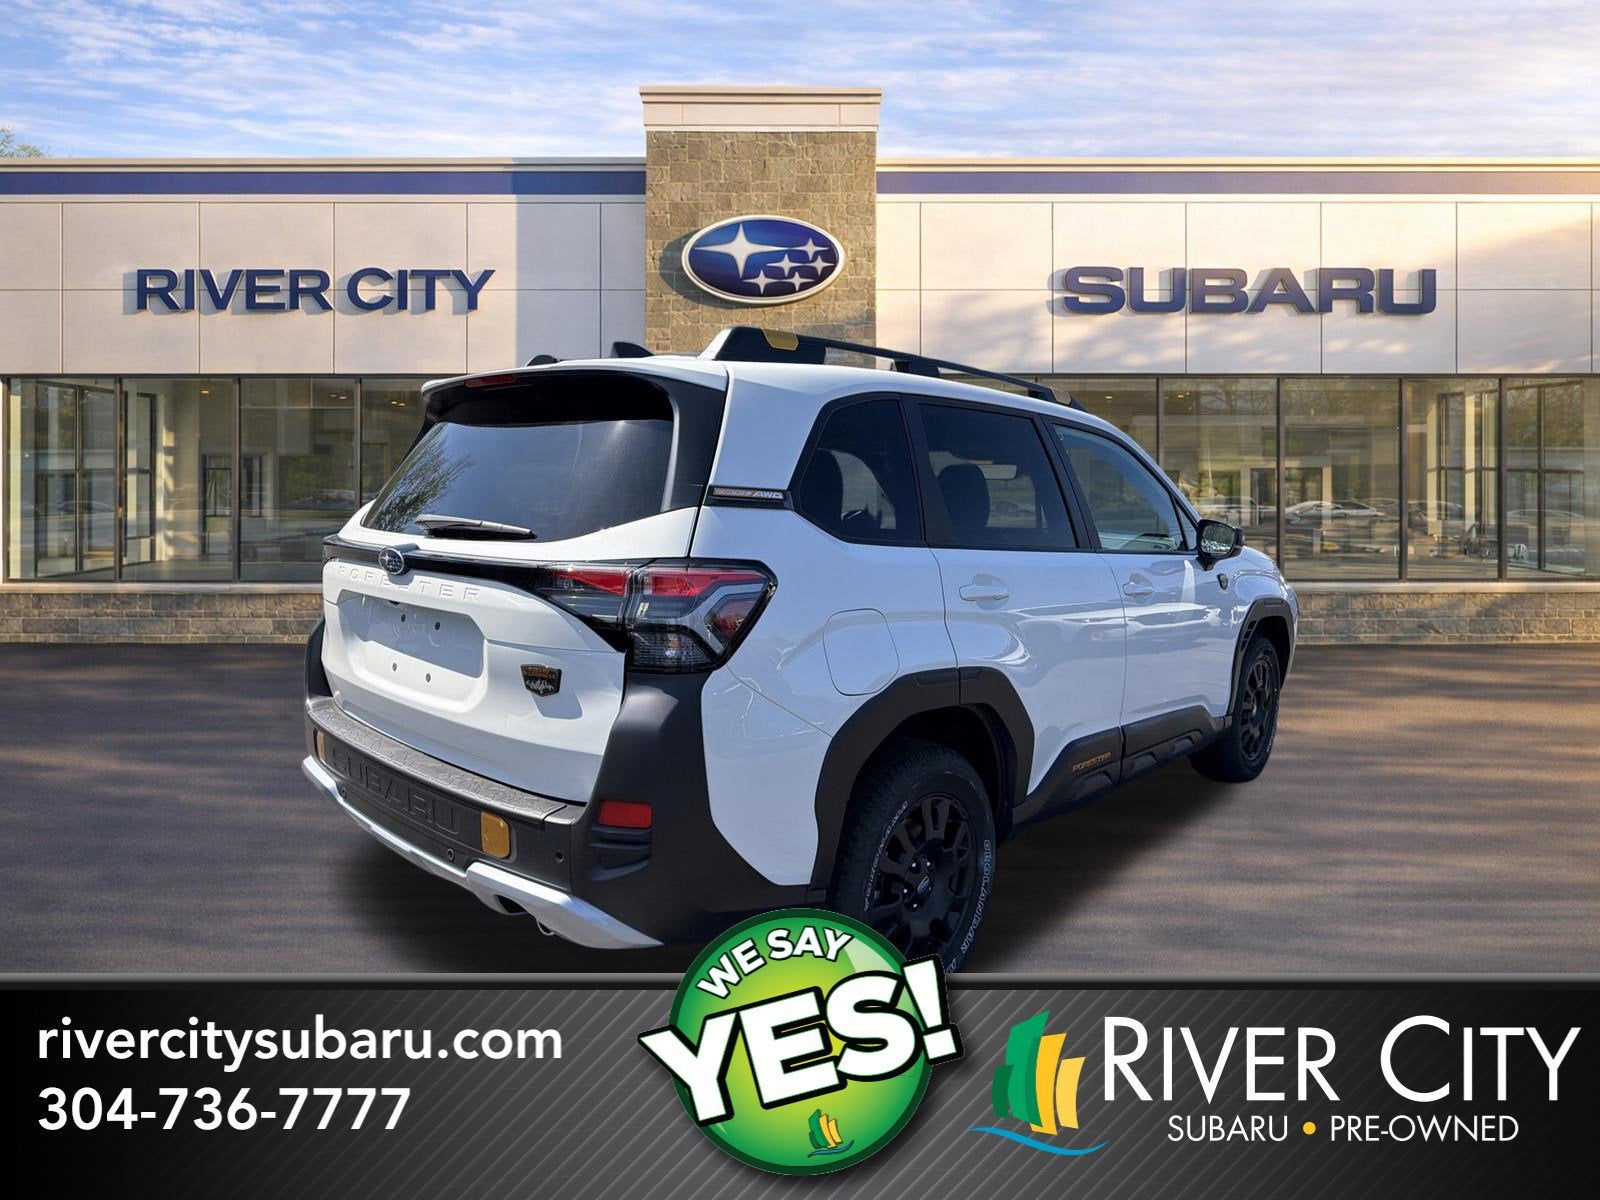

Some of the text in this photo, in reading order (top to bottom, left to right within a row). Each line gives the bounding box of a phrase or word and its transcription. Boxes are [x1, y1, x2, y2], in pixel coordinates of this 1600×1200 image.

[136, 267, 496, 312] RIVER CITY
[1062, 265, 1437, 316] SUBARU
[336, 564, 482, 604] FORETER
